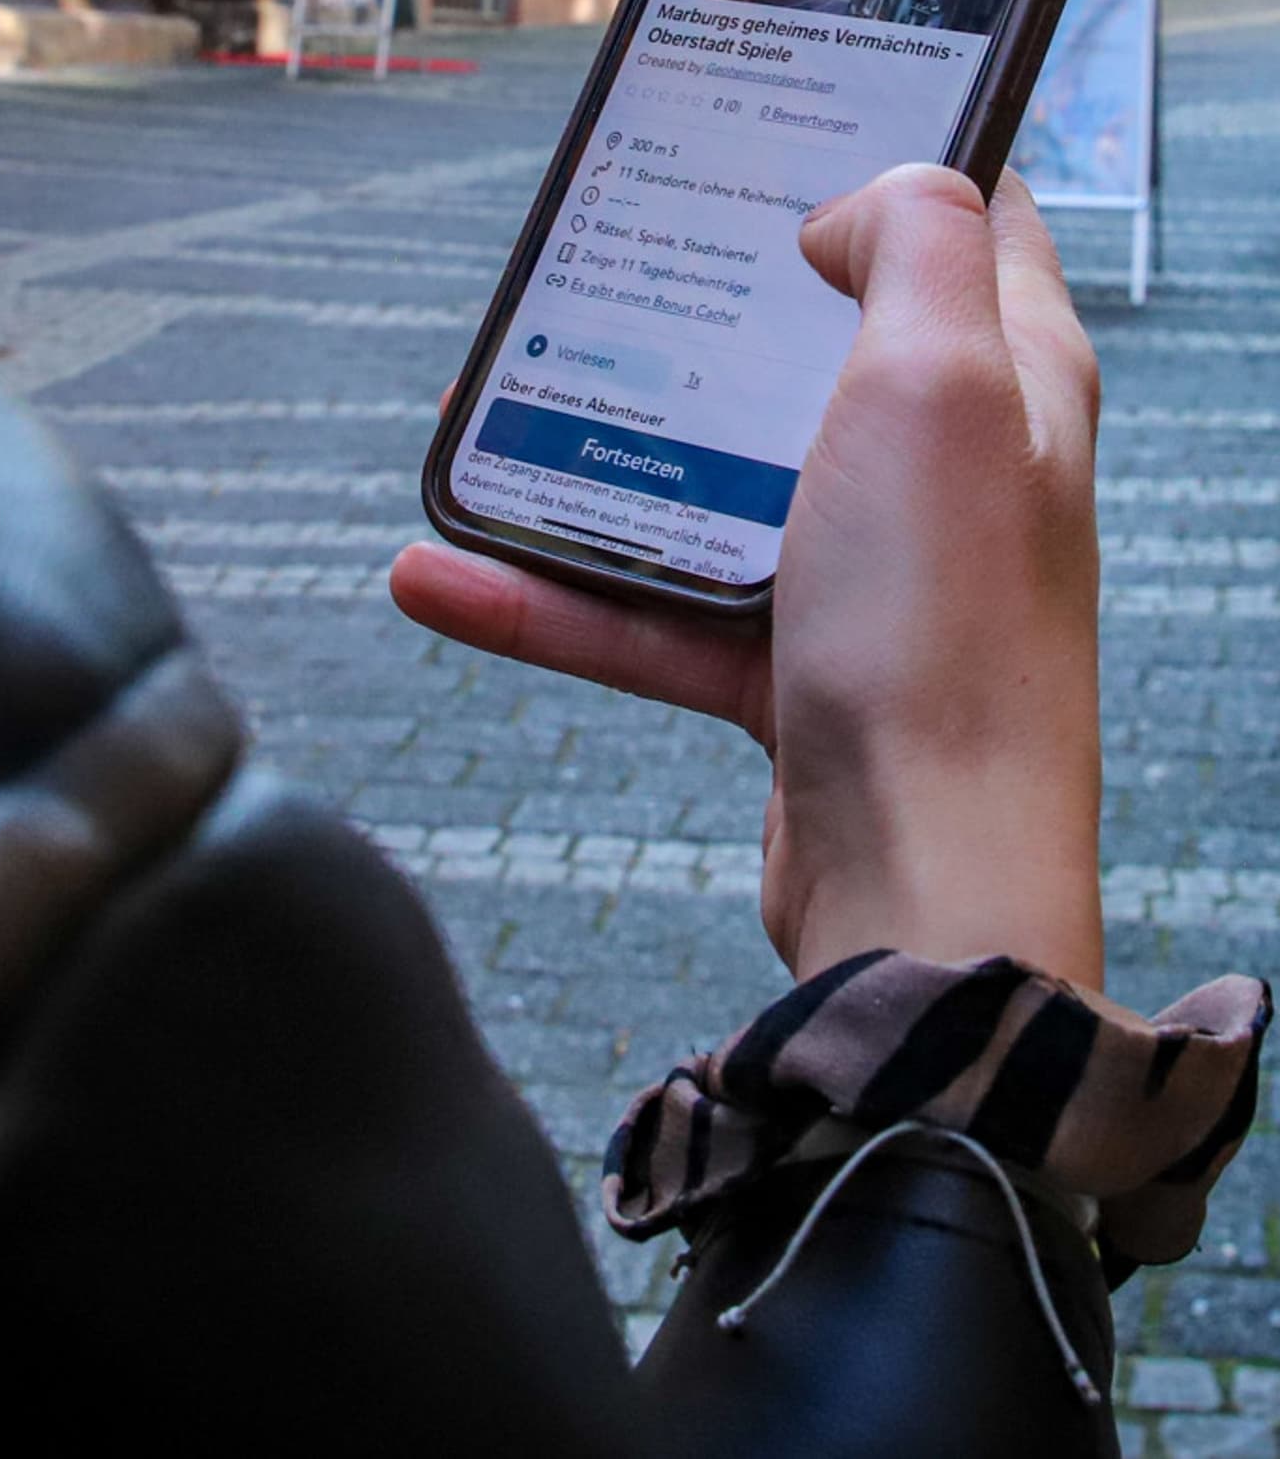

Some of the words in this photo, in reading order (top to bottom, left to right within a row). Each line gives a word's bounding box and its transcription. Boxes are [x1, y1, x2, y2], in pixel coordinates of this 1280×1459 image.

[648, 27, 735, 55] Oberstadt
[737, 42, 793, 63] Spiele
[656, 3, 740, 31] Marburgs
[741, 14, 830, 42] geheimes
[835, 28, 951, 60] Vermächtnis
[638, 53, 684, 72] Created
[688, 60, 704, 75] by
[713, 97, 723, 111] 0
[724, 99, 742, 116] (0)
[760, 104, 771, 119] 0
[772, 107, 859, 133] Bewertungen
[628, 137, 653, 153] 300
[654, 144, 667, 156] m
[669, 144, 680, 158] S
[618, 166, 633, 179] 11
[635, 168, 697, 192] Standorte
[699, 180, 735, 199] (ohne
[637, 229, 679, 251] Spiele,
[681, 237, 759, 264] Stadtviertel
[580, 249, 617, 271] Zeige
[619, 257, 635, 271] 11
[637, 260, 753, 298] Tagebucheinträge
[570, 277, 587, 292] Es
[587, 283, 614, 298] gibt
[616, 289, 651, 305] einen
[652, 295, 692, 316] Bonus
[695, 304, 742, 327] Cache!
[556, 344, 616, 371] Vorlesen
[686, 371, 704, 389] 1x
[499, 372, 536, 395] Über
[537, 385, 583, 409] dieses
[585, 396, 666, 428] Abenteuer
[580, 437, 685, 481] Fortsetzen
[467, 451, 492, 467] den
[493, 456, 542, 483] Zugang
[542, 473, 610, 498] zusammen
[612, 489, 672, 513] zutragen.
[676, 502, 711, 524] Zwei
[458, 471, 524, 499] Adventure
[524, 489, 555, 508] Labs
[556, 498, 597, 519] helfen
[598, 510, 631, 528] euch
[633, 520, 702, 546] vermutlich
[704, 537, 746, 561] dabei,
[470, 500, 531, 524] restlichen
[669, 555, 692, 569] um
[693, 559, 726, 579] alles
[727, 570, 745, 583] zu
